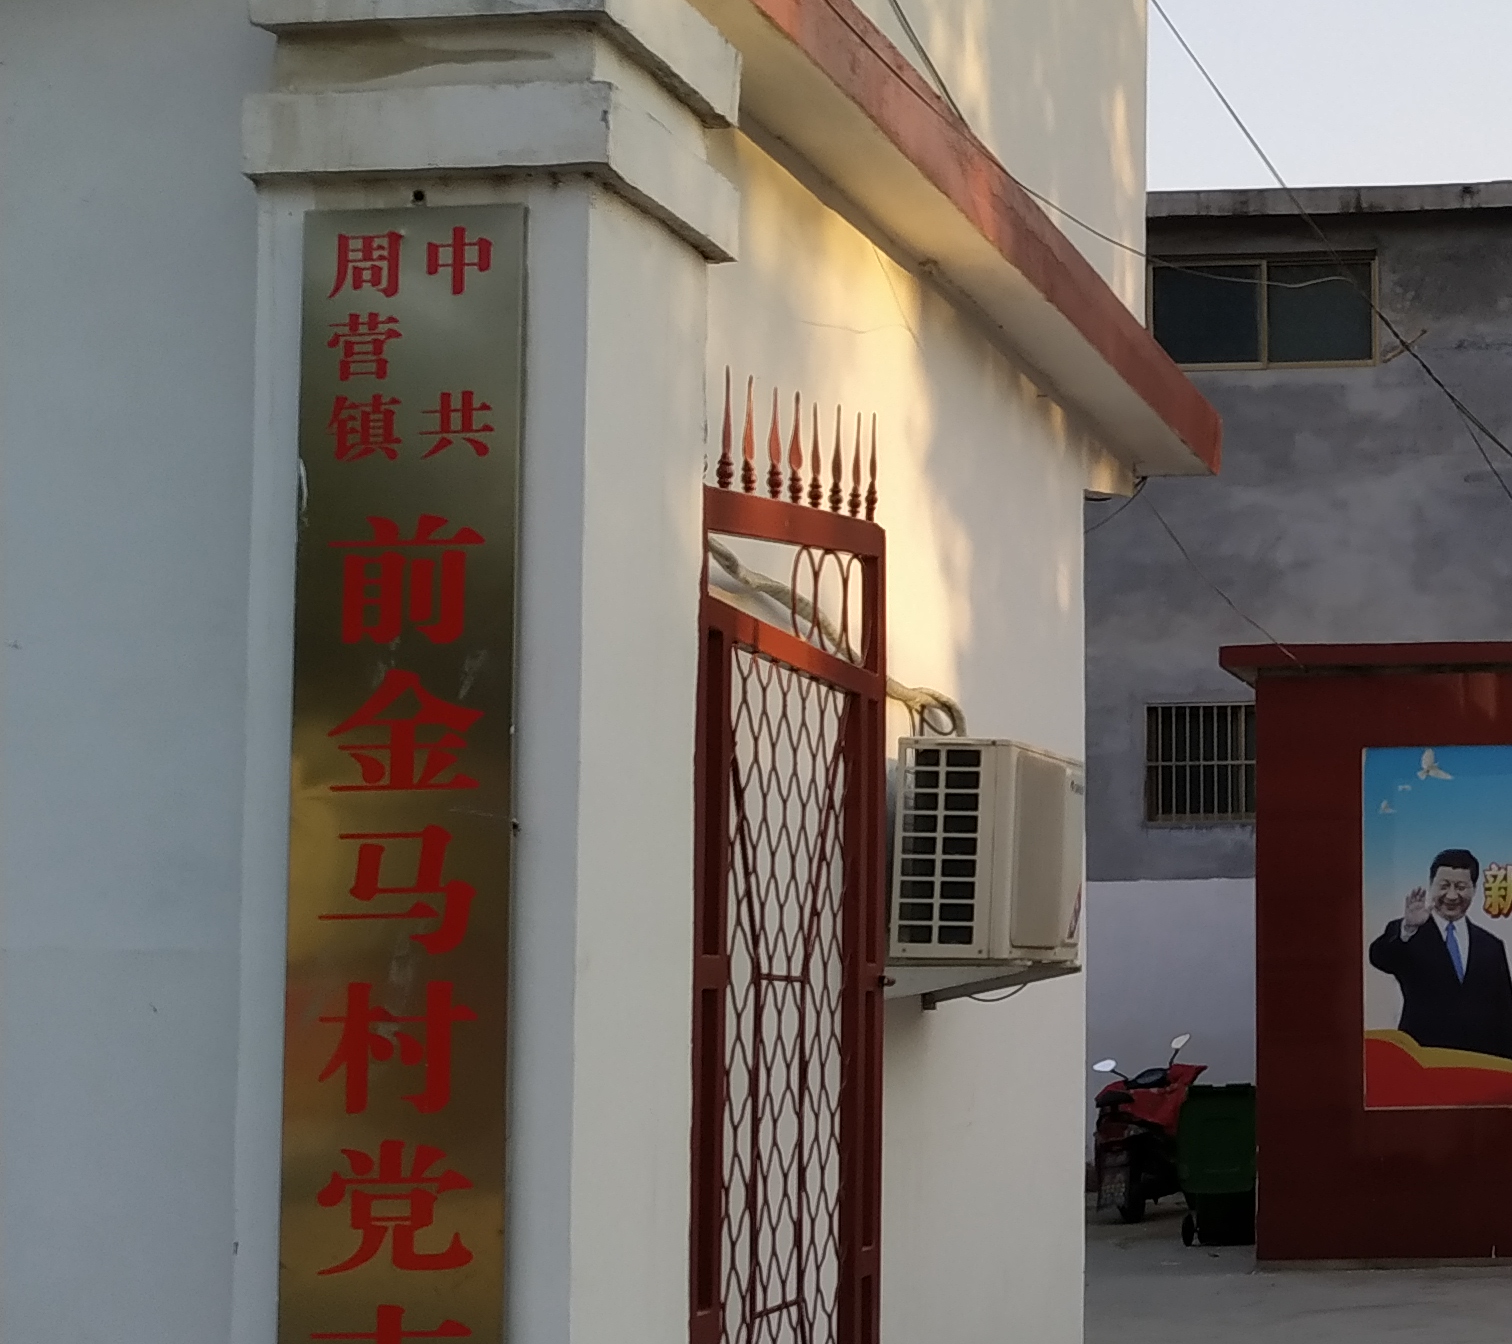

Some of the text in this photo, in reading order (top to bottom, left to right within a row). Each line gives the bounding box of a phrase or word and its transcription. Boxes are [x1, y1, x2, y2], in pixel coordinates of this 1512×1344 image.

[327, 229, 404, 462] 周营镇
[420, 226, 495, 459] 中共
